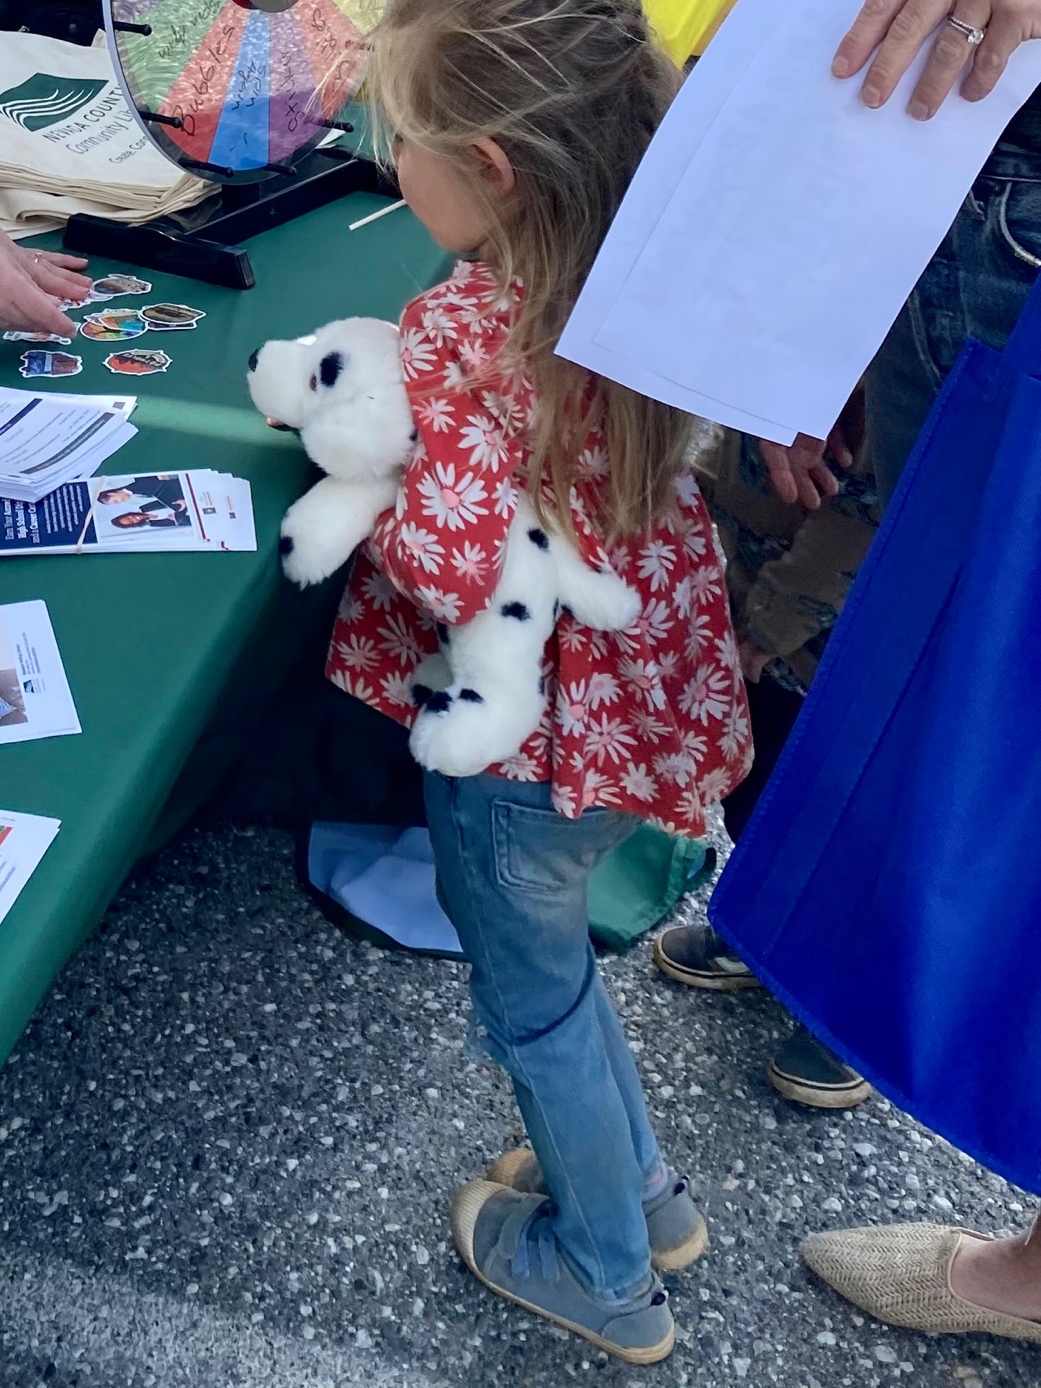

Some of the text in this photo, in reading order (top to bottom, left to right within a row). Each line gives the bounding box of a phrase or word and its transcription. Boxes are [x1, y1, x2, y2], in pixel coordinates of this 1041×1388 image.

[171, 25, 235, 137] Bubbles
[43, 122, 91, 143] NEVADA
[65, 121, 129, 156] Community
